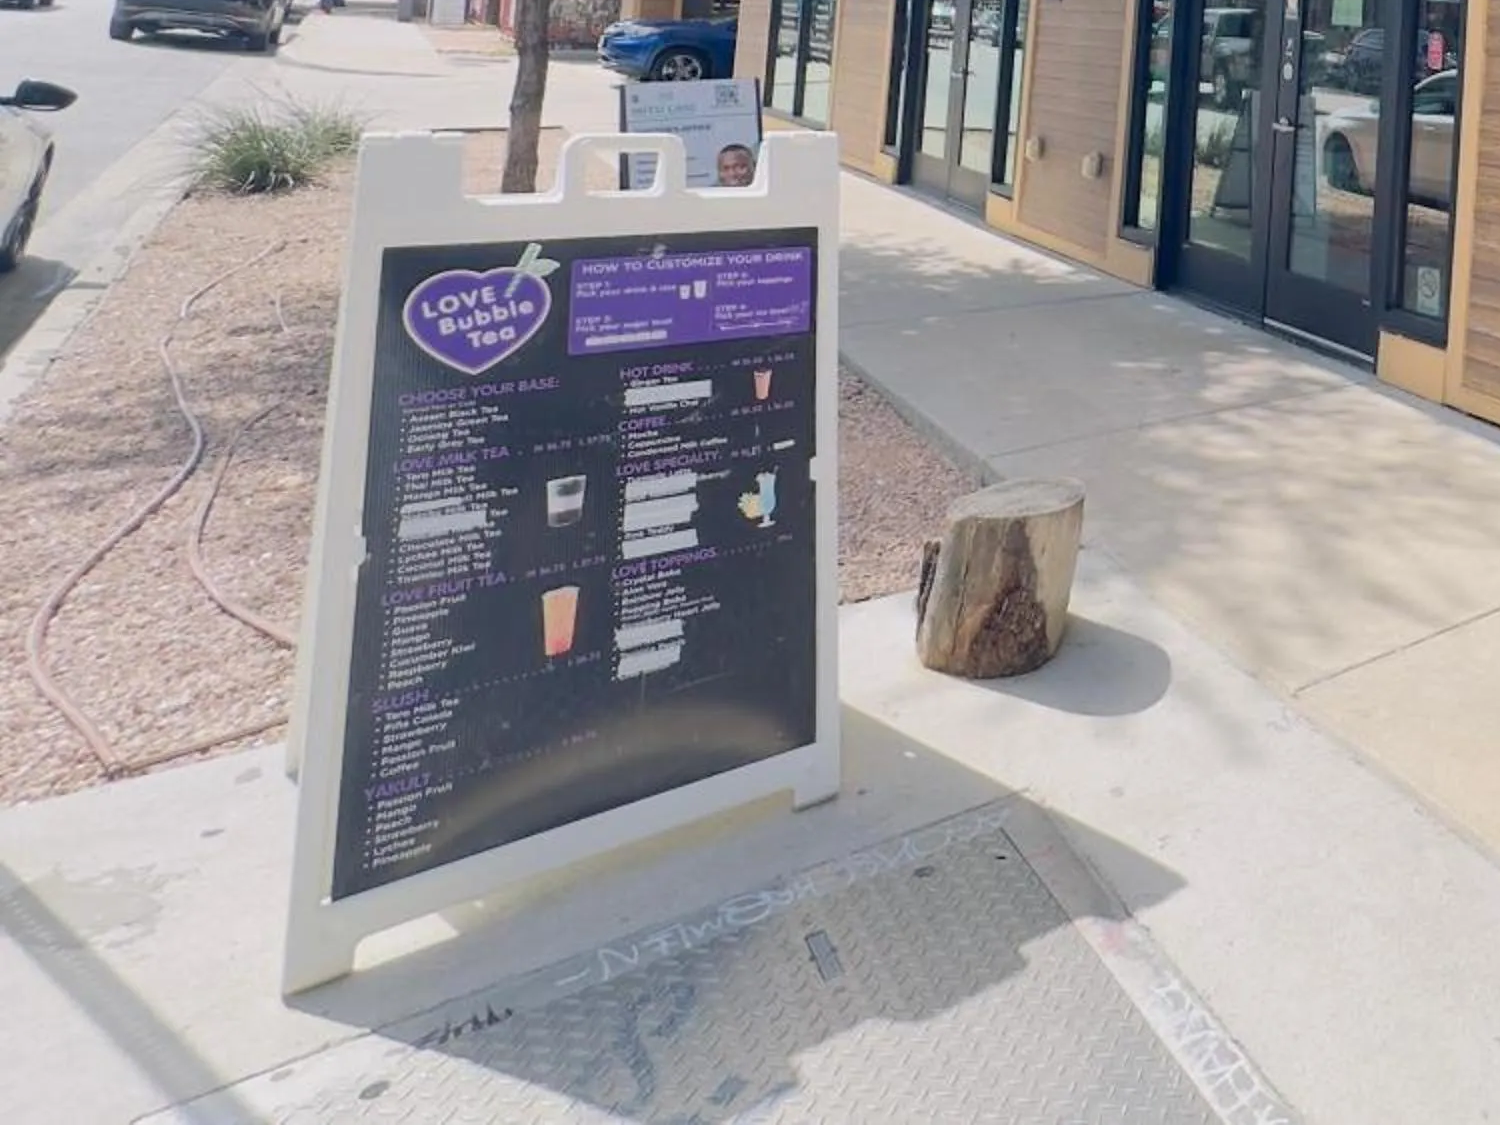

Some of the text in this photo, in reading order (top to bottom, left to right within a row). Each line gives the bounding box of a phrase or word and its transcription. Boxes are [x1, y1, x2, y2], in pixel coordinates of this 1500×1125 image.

[582, 251, 803, 275] HOW TO CUSTOMIZE YOUR DRINK
[422, 286, 496, 318] LOVE
[438, 300, 534, 335] Bubble
[467, 326, 516, 348] Tea
[620, 362, 694, 380] HOT DRINK
[399, 376, 560, 406] CHOOSE YOUR BASE:
[481, 405, 499, 414] Tea
[456, 416, 488, 426] Green
[490, 414, 509, 422] Tea
[618, 416, 668, 432] COFFEE
[452, 428, 471, 437] Tea
[467, 436, 485, 445] Tea
[394, 457, 434, 473] LOVE
[439, 451, 477, 467] MILK
[483, 445, 509, 459] TEA
[432, 469, 453, 477] Milk
[457, 465, 476, 473] Tea
[617, 462, 649, 476] LOVE
[405, 475, 474, 491] Thai Milk Tea
[443, 487, 465, 497] Milk
[469, 483, 487, 491] Tea
[476, 487, 519, 499] Milk Tea
[490, 508, 508, 517] Tea
[484, 529, 502, 538] Tea
[440, 546, 463, 555] Milk
[467, 543, 484, 551] Tea
[448, 555, 470, 564] Milk
[473, 551, 492, 560] Tea
[448, 566, 469, 575] Milk
[473, 561, 491, 570] Tea
[612, 547, 717, 579] LOVE TOPPINGS
[381, 588, 425, 606] LOVE
[429, 579, 472, 598] FRUIT
[477, 572, 506, 586] TEA
[393, 594, 467, 615] Passion Fruit
[392, 623, 428, 636] Guava
[390, 639, 453, 658] Strawberry
[391, 632, 430, 647] Mango
[389, 642, 476, 668] Cucumber Kiwi
[388, 676, 423, 690] Peach
[372, 689, 430, 713] SLUSH
[385, 698, 459, 721] Taro Milk Tea
[383, 723, 447, 744] Strawberry
[380, 740, 456, 766] Passion Fruit
[382, 739, 422, 755] Mango
[379, 762, 419, 778] Coffee
[365, 775, 430, 800] YAKULT
[377, 783, 452, 810] Passion Fruit
[376, 804, 417, 822] Mango
[375, 815, 412, 832] Peach
[375, 820, 439, 844] Strawberry
[373, 838, 415, 857] Lychee
[373, 843, 432, 868] Pineapple
